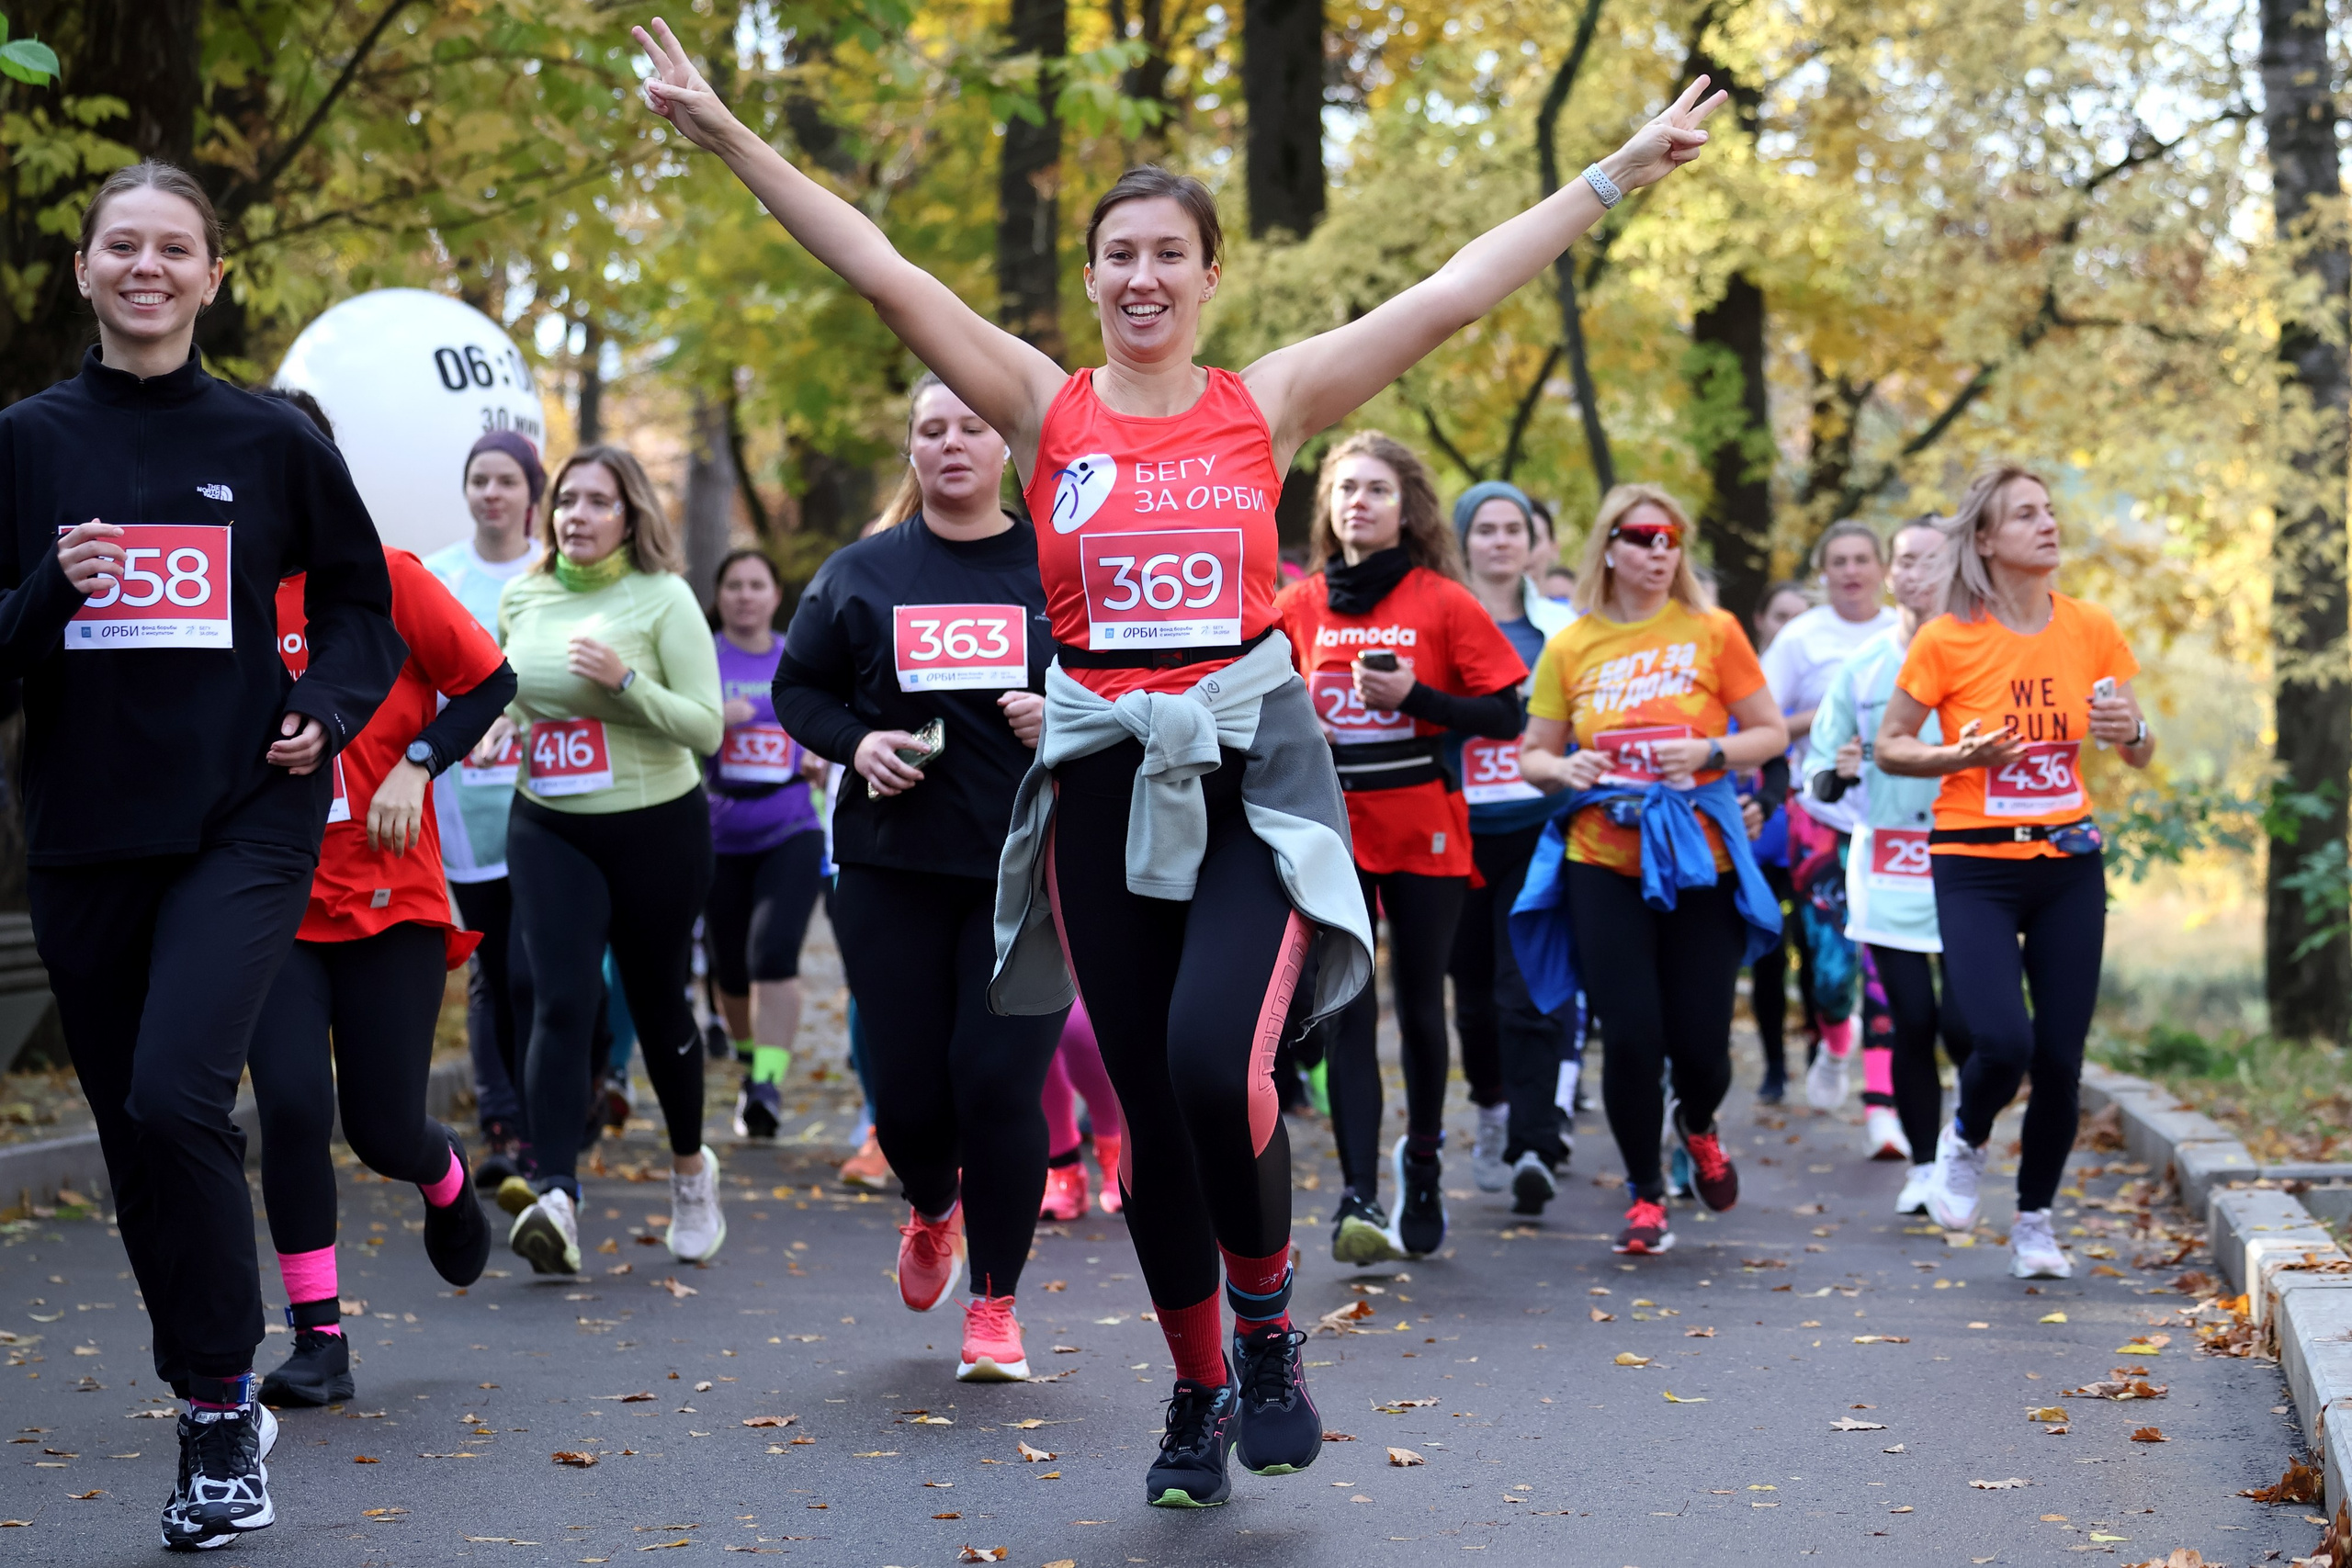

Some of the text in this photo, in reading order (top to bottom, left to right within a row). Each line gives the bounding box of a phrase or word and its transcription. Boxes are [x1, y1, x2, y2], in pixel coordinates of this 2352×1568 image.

[1136, 455, 1216, 483] БЕГУ
[1134, 485, 1266, 513] ЗА ОРБИ
[1098, 551, 1224, 611] 369
[101, 626, 139, 637] ОРБИ
[909, 618, 1010, 661] 363
[1123, 626, 1158, 638] ОРБИ
[1314, 623, 1417, 648] lamoda
[926, 672, 956, 682] ОРБИ
[2010, 677, 2056, 708] WE
[2004, 711, 2069, 741] RUN
[533, 728, 594, 770] 416
[1473, 746, 1521, 782] 35
[1618, 739, 1665, 774] 41
[1996, 751, 2072, 791] 436
[1883, 838, 1932, 874] 29
